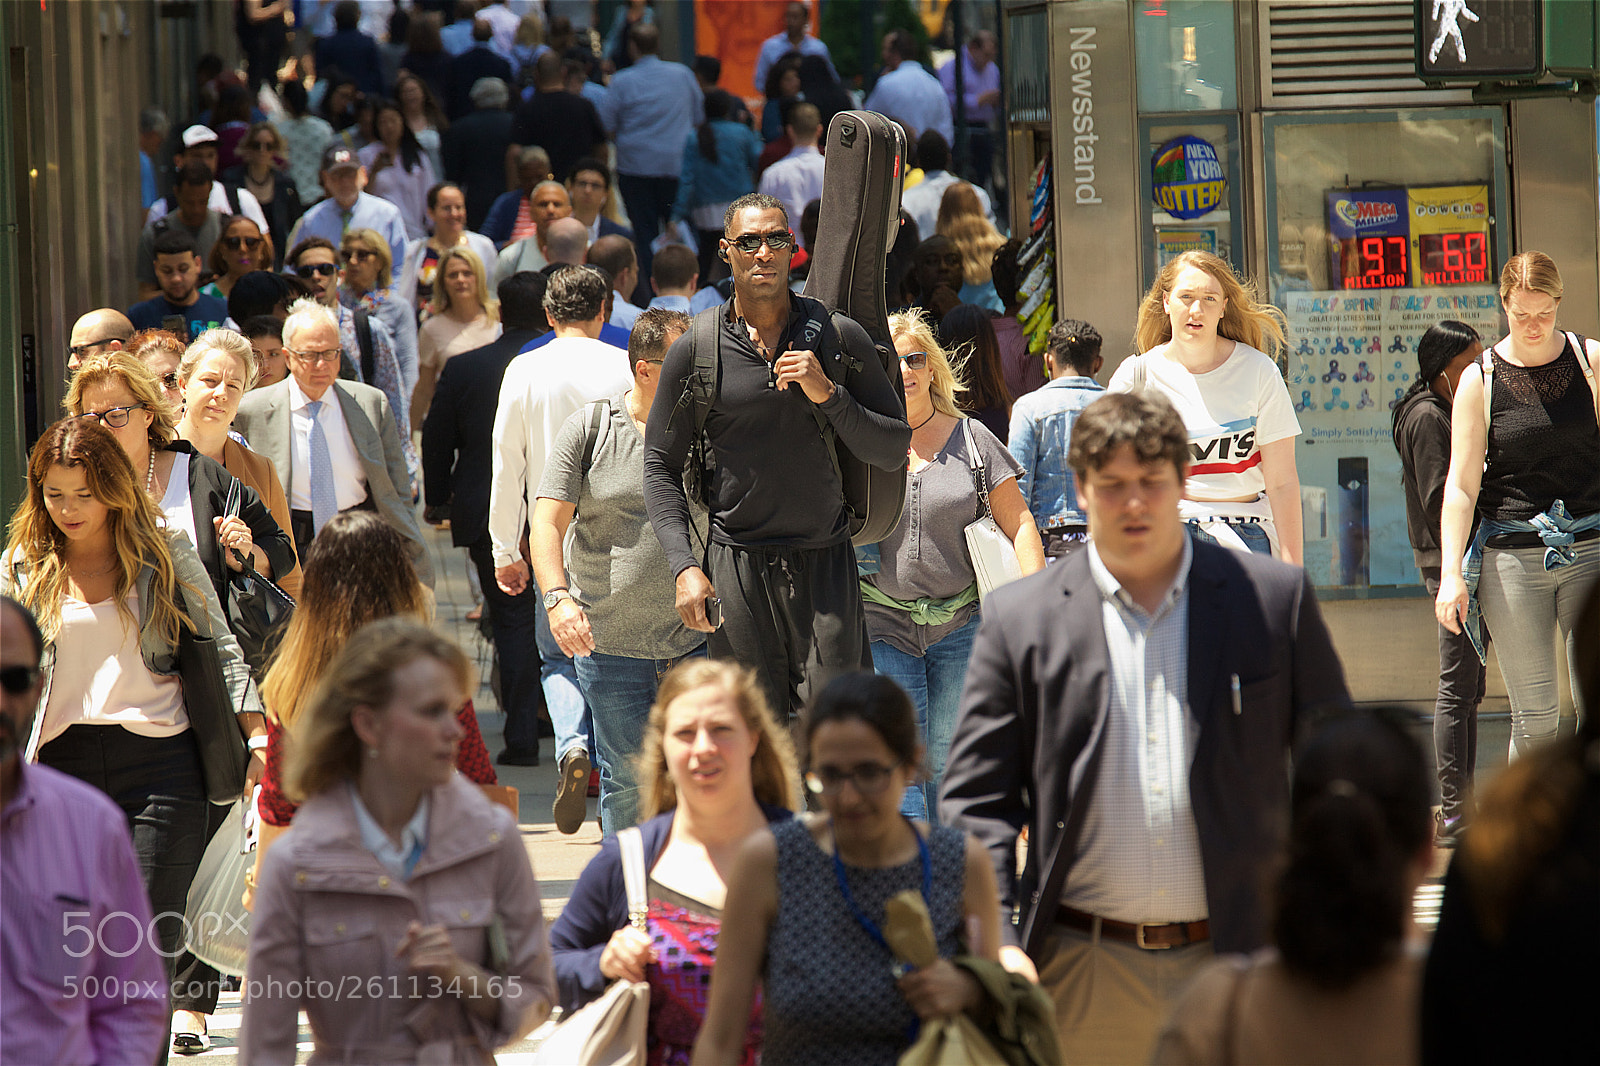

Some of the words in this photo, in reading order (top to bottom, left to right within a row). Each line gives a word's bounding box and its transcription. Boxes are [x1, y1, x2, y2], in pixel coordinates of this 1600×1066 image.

[1069, 26, 1103, 204] Newsstand
[1186, 143, 1216, 160] NEW
[1356, 201, 1397, 219] MEGA
[1415, 203, 1474, 217] POWER
[1362, 237, 1406, 276] 97
[1442, 233, 1486, 271] 60
[1344, 274, 1406, 289] MILLION
[1424, 270, 1485, 285] MILLION
[1309, 315, 1328, 323] GREAT
[1460, 311, 1480, 319] RELIEF
[1312, 427, 1342, 439] Simply
[1346, 426, 1394, 439] Satisfying
[1187, 431, 1255, 461] VI'S
